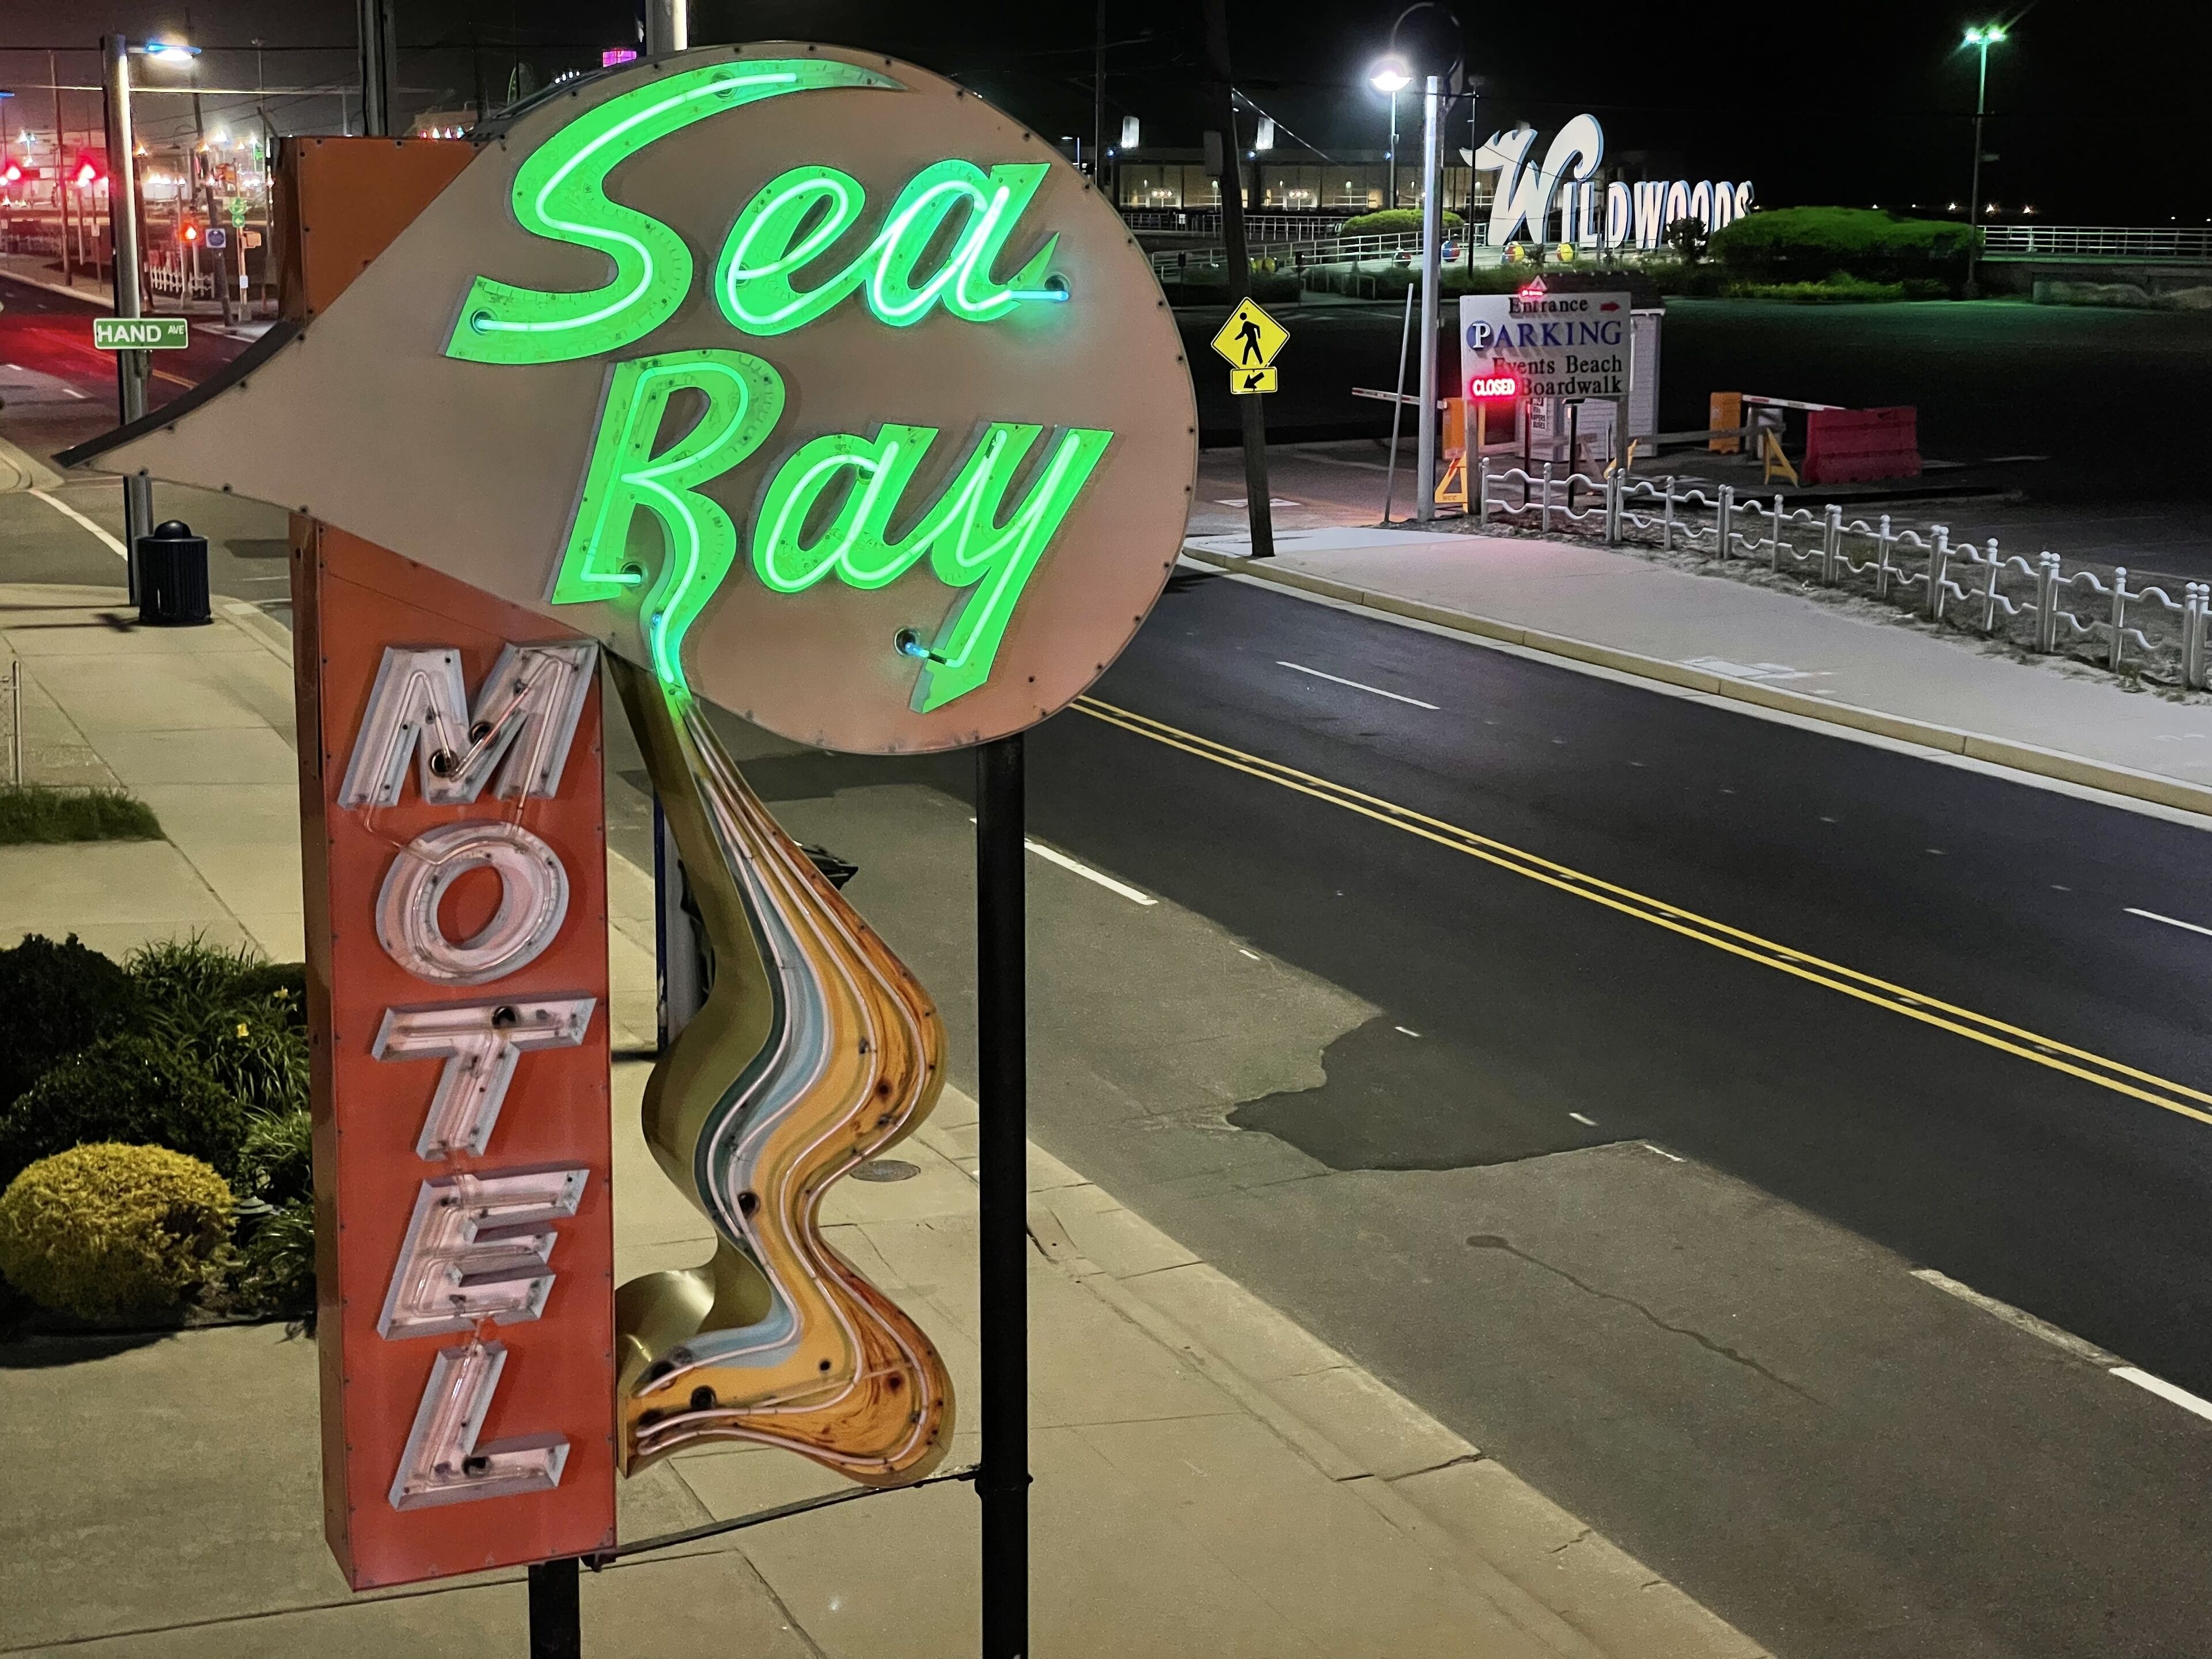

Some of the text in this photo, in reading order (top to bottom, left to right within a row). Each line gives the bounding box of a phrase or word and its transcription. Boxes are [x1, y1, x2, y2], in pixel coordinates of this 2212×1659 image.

[1459, 113, 1754, 249] WILDWOODS
[445, 59, 1061, 365] Sea
[1508, 296, 1589, 313] Entrance
[97, 324, 185, 342] HAND AVE
[1472, 320, 1622, 349] PARKING
[1492, 354, 1622, 374] Events Beach
[1472, 378, 1516, 396] CLOSED
[1521, 375, 1623, 396] Boardwalk
[547, 349, 1114, 713] Ray
[337, 641, 600, 1513] MOTEL
